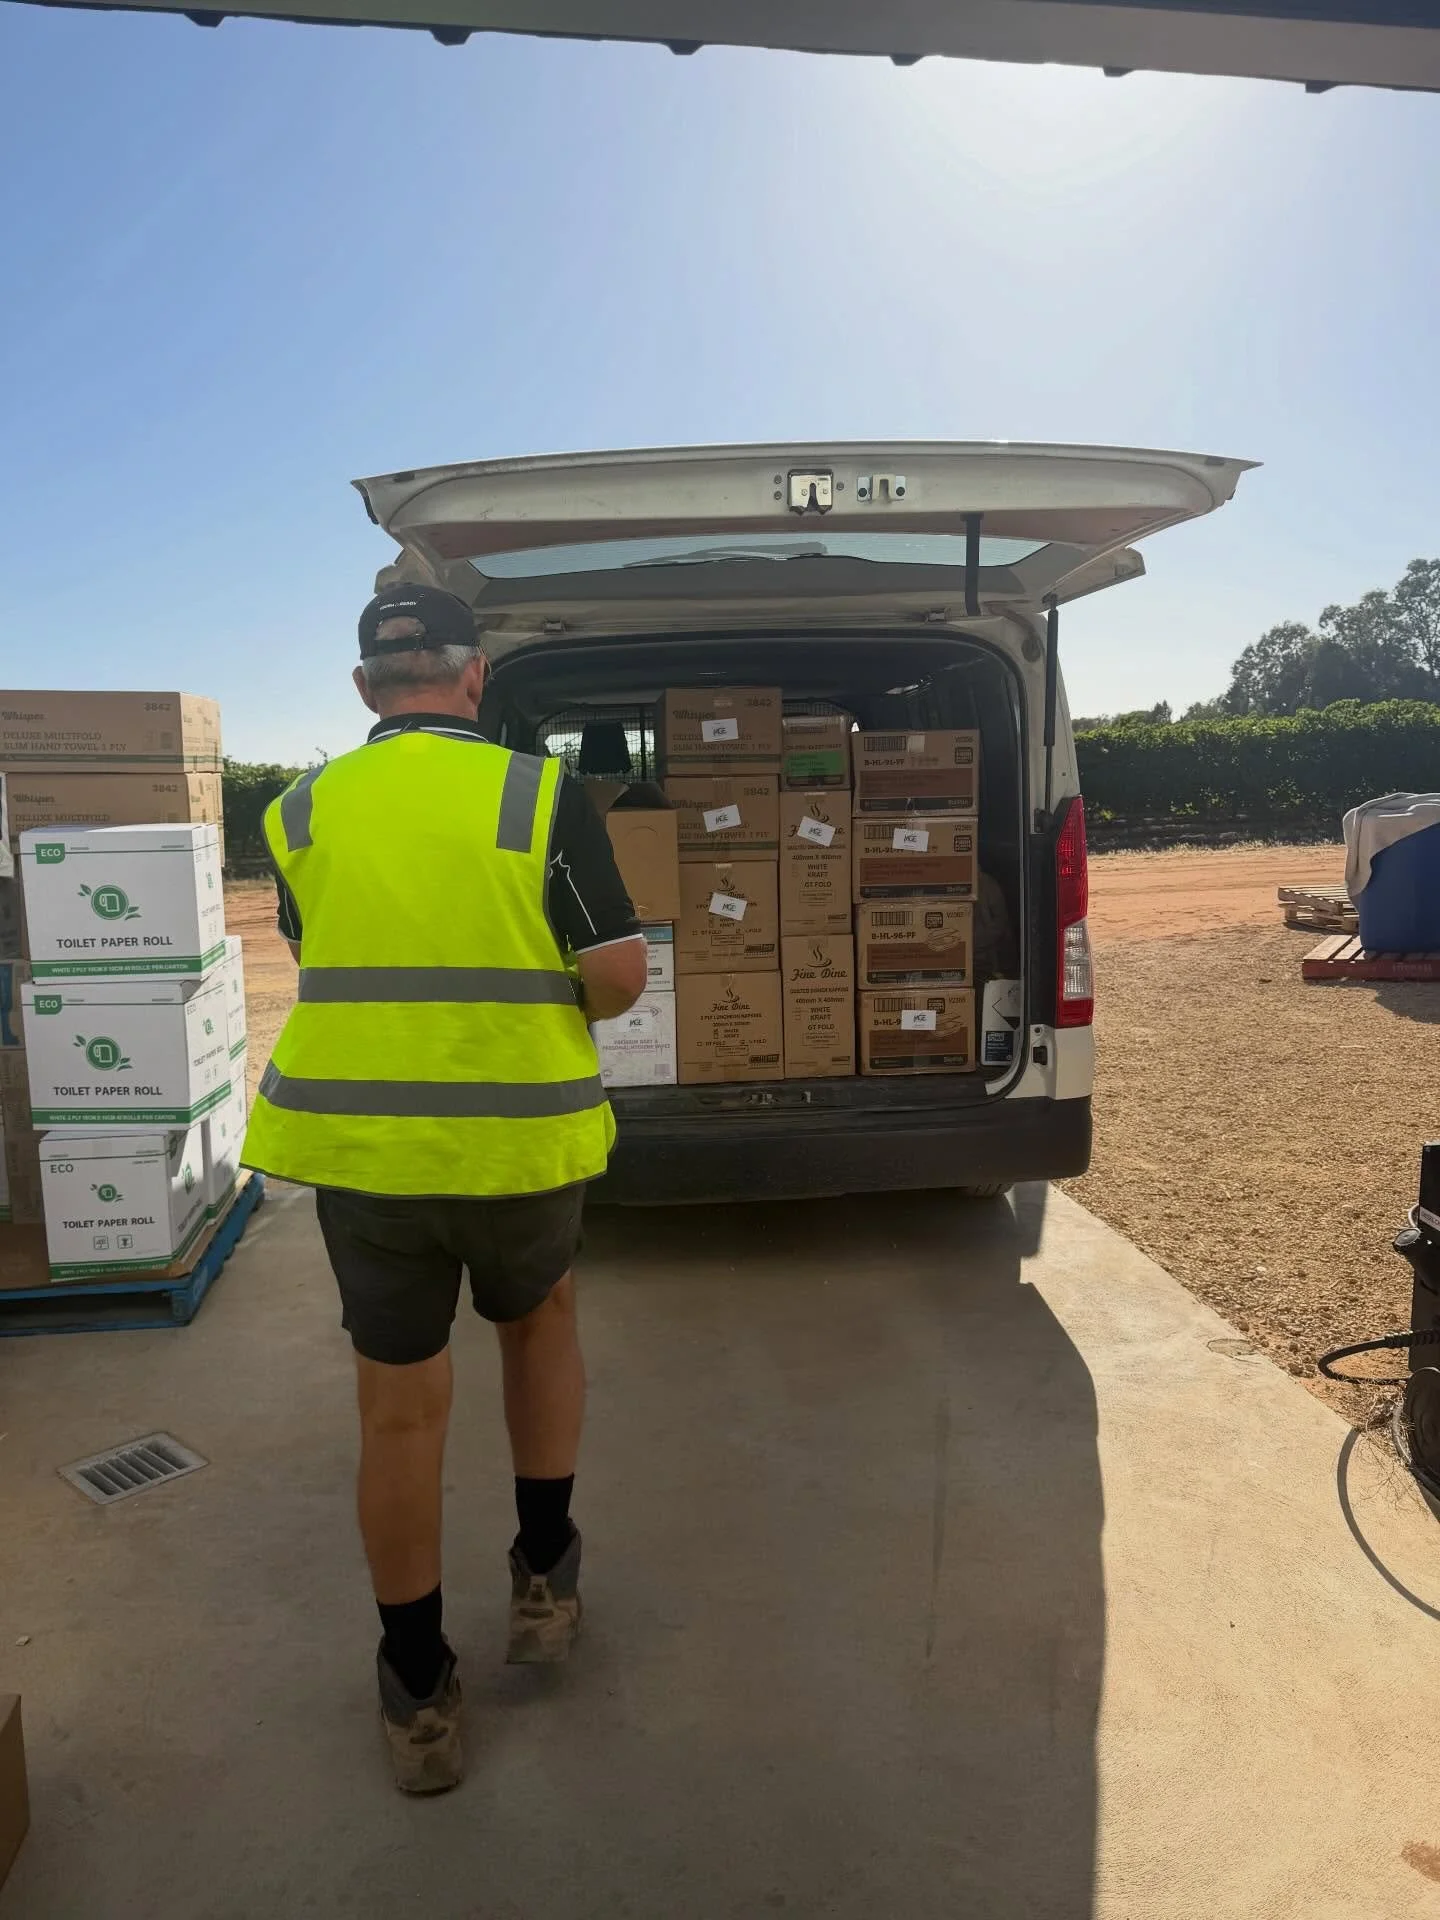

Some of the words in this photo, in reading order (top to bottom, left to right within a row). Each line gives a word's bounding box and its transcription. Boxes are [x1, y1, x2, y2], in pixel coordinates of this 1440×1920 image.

[144, 703, 171, 711] 3842
[3, 731, 41, 740] DELUXE
[44, 731, 102, 740] MULTIFOLD
[4, 742, 28, 750] SLIM
[32, 742, 60, 751] HAND
[63, 742, 97, 751] TOWEL
[152, 784, 178, 792] 3842
[744, 788, 770, 796] 3842
[40, 848, 61, 857] ECO
[56, 938, 96, 948] TOILET
[101, 937, 138, 947] PAPER
[143, 936, 173, 946] ROLL
[790, 968, 817, 982] Fine
[820, 967, 847, 979] Dine
[39, 1000, 58, 1008] ECO
[53, 1086, 90, 1096] TOILET
[95, 1086, 130, 1096] PAPER
[135, 1086, 163, 1096] ROLL
[50, 1164, 74, 1174] ECO
[62, 1220, 95, 1229] TOILET
[98, 1218, 128, 1227] PAPER
[131, 1216, 156, 1225] ROLL
